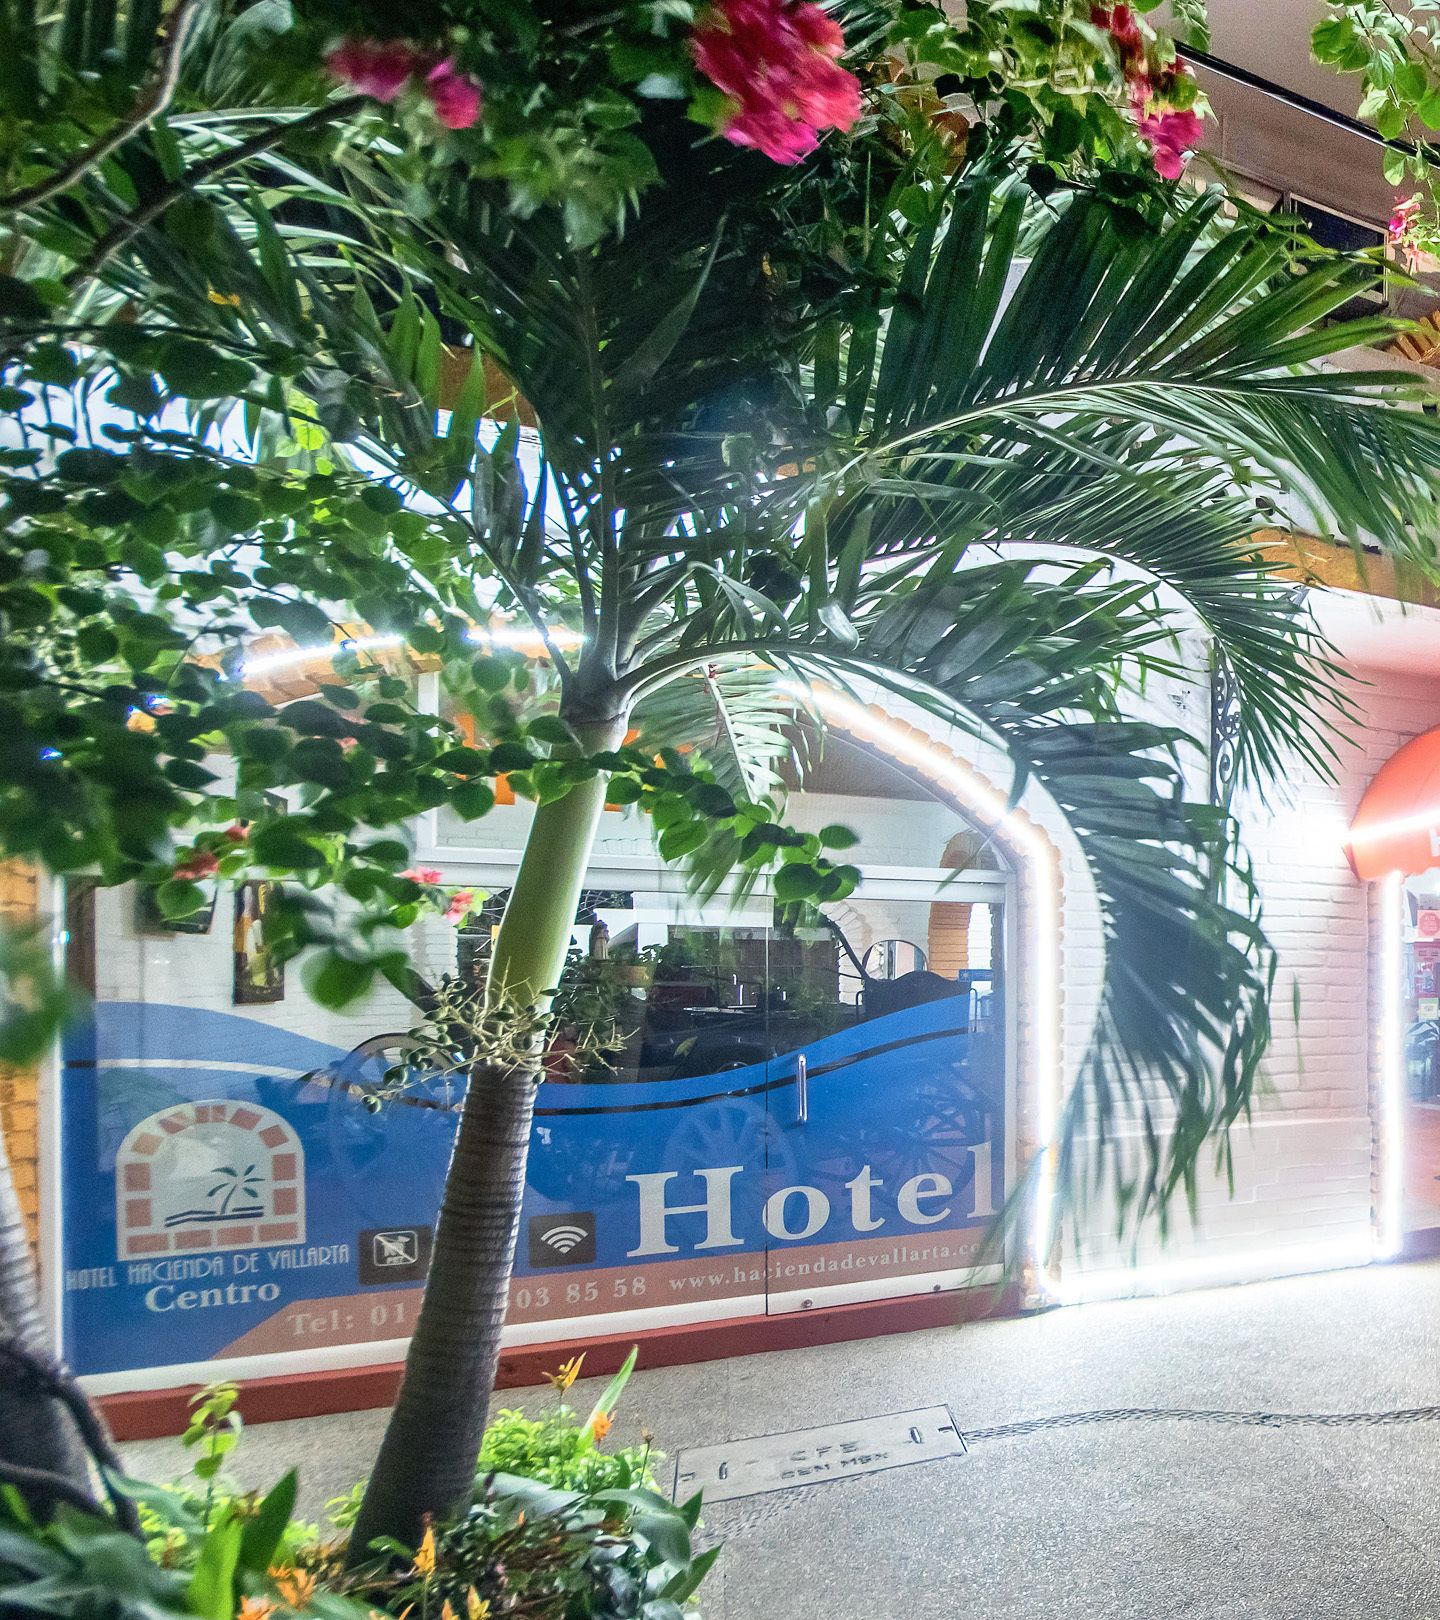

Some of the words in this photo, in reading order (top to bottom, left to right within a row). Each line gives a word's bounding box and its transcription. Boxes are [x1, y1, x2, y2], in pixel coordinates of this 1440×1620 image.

[626, 1141, 1000, 1258] Hotel
[65, 1266, 118, 1291] HOTEL
[128, 1255, 224, 1285] HACIENDA
[233, 1253, 260, 1275] DE
[267, 1243, 350, 1271] VALLARTA
[145, 1282, 281, 1313] Centro
[285, 1309, 354, 1336] Tel:
[565, 1281, 600, 1305] 85
[613, 1276, 647, 1298] 58
[670, 1242, 994, 1291] www.haciendadevallarta.co
